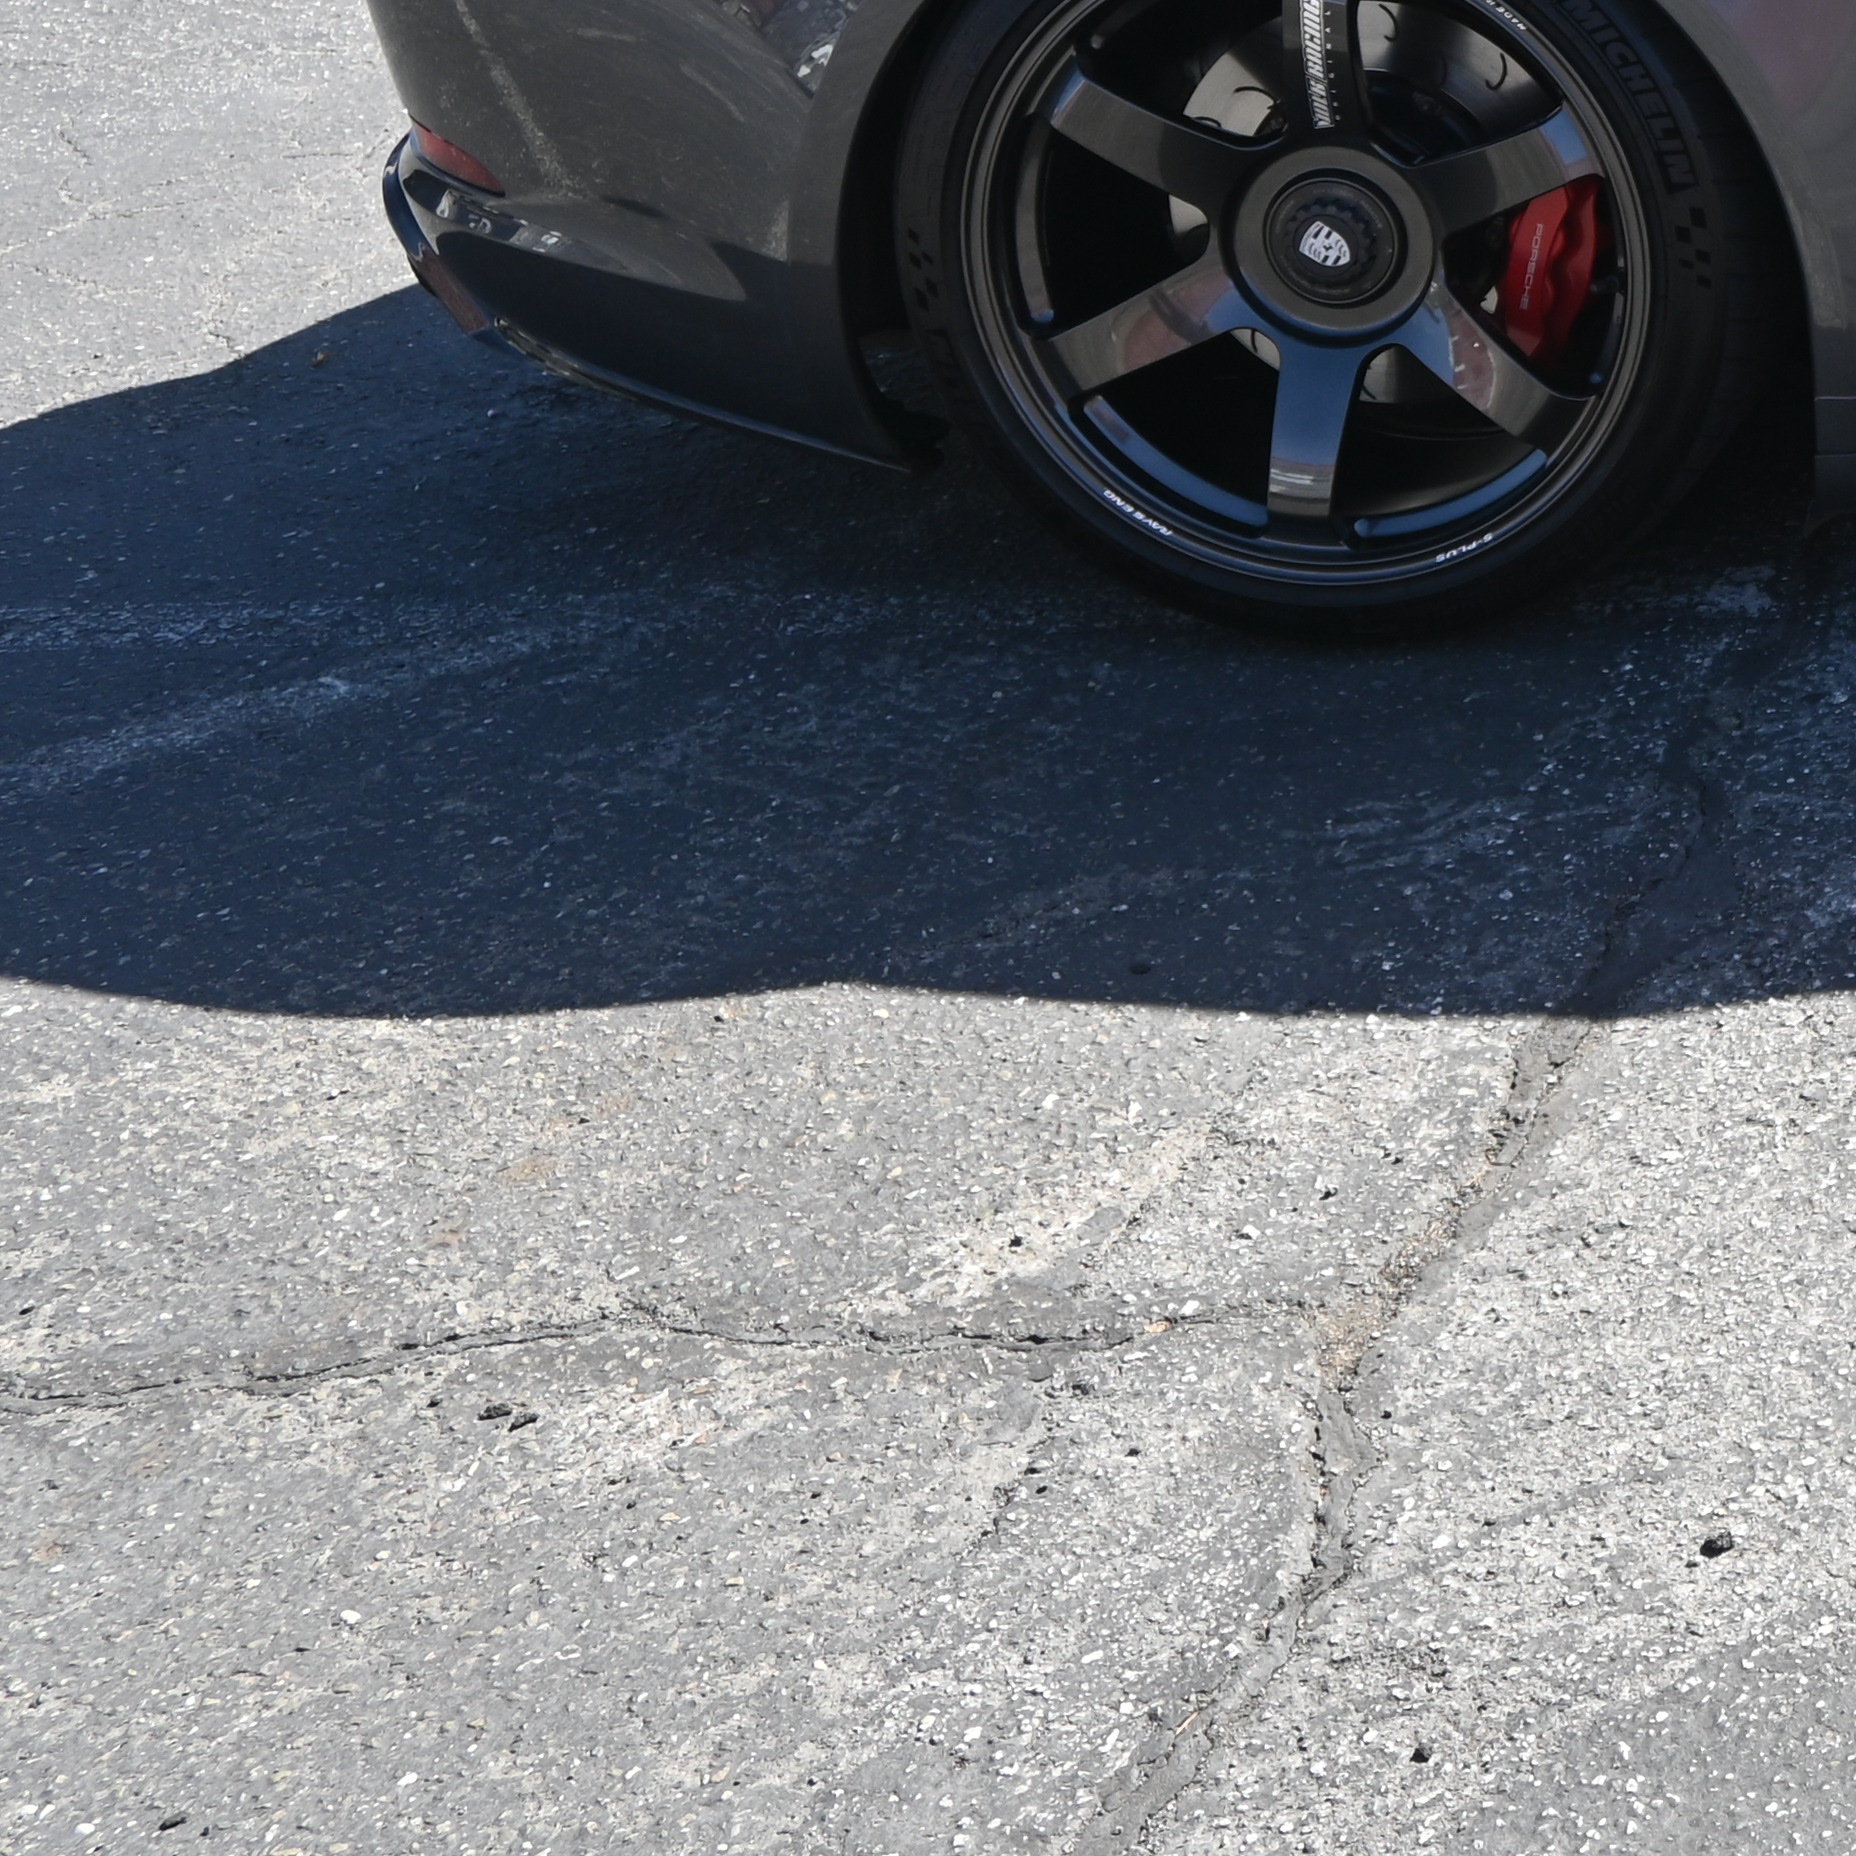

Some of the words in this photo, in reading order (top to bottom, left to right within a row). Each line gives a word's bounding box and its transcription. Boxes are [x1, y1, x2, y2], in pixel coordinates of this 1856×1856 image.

[1496, 6, 1527, 30] MADE
[1306, 78, 1334, 129] VOLK
[1519, 223, 1544, 311] PORSCHE
[1133, 511, 1173, 536] RAYS
